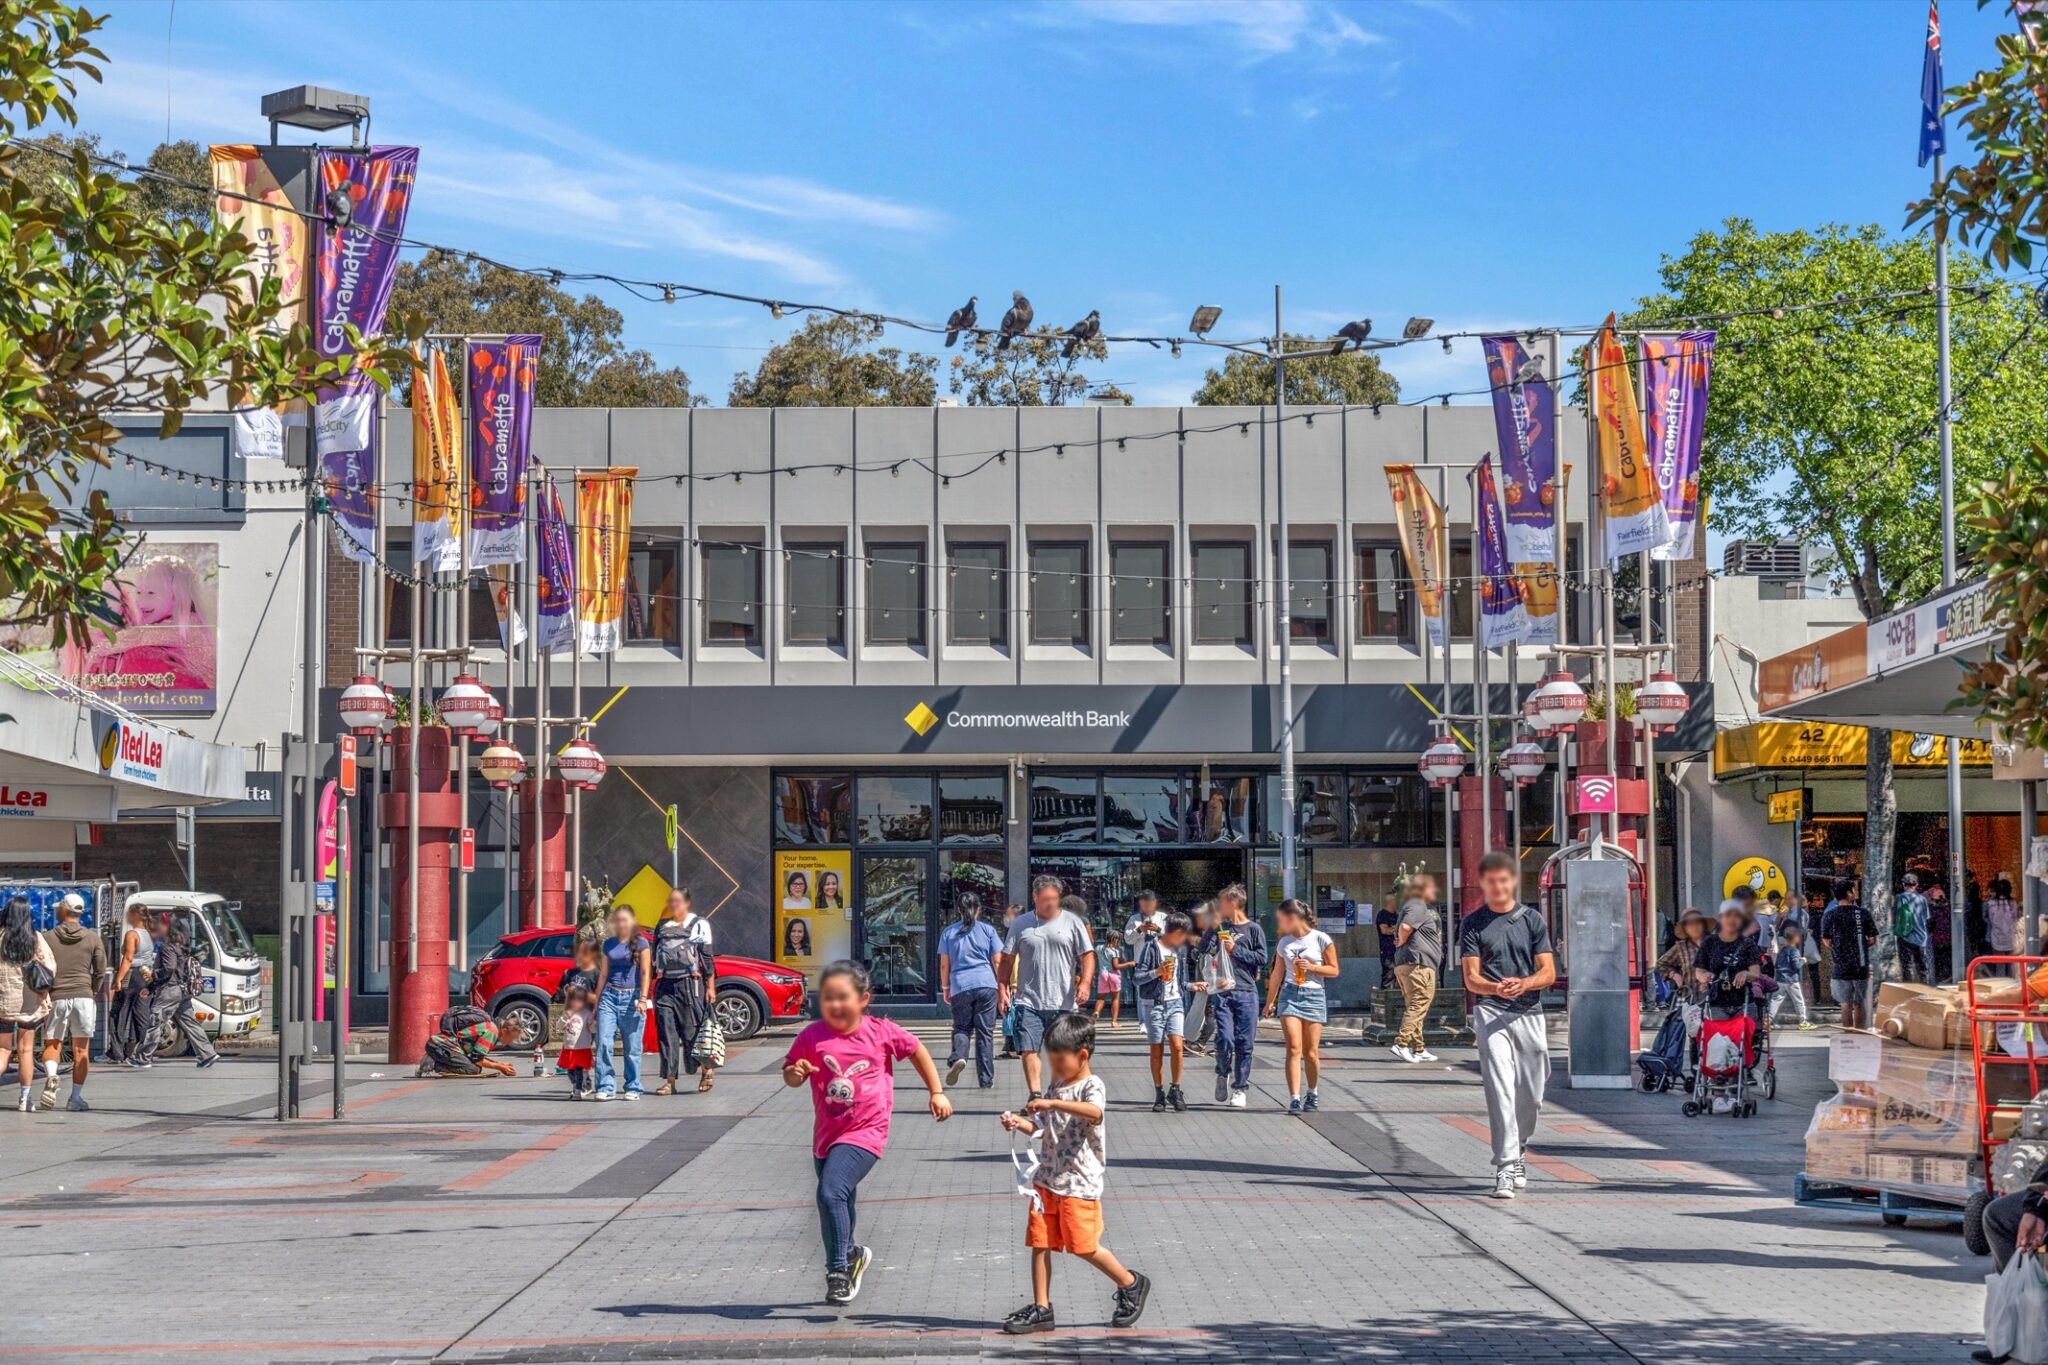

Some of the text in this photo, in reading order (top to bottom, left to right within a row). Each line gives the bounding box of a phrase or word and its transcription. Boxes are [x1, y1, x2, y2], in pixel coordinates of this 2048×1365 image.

[322, 221, 372, 354] Cabramatta
[491, 393, 514, 495] Cabramatta
[1657, 387, 1685, 490] Cabramatta
[946, 710, 1130, 727] Commonwealth Bank
[1799, 728, 1825, 742] 42
[120, 725, 163, 769] Red Lea
[1789, 755, 1812, 763] 0449
[1814, 755, 1831, 763] 666
[0, 785, 47, 808] Lea
[245, 786, 272, 801] tta
